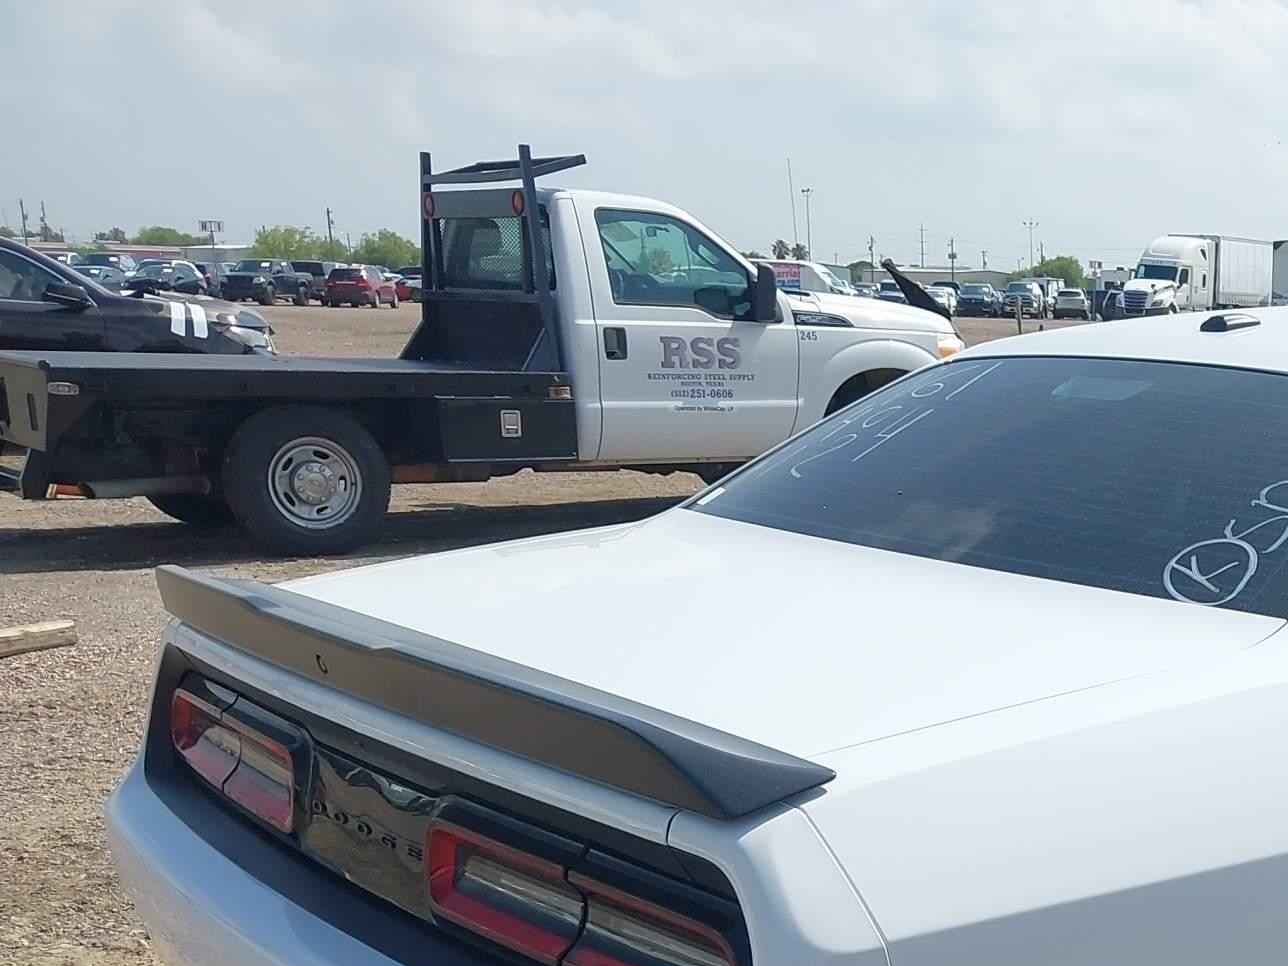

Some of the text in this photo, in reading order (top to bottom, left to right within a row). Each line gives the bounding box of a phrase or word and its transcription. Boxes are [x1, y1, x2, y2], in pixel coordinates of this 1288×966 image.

[800, 331, 818, 341] 245
[659, 336, 742, 370] RSS
[647, 373, 702, 381] REINFORCING
[704, 373, 727, 381] STEEL
[690, 389, 734, 399] 251-0606
[312, 799, 424, 862] DODGE
